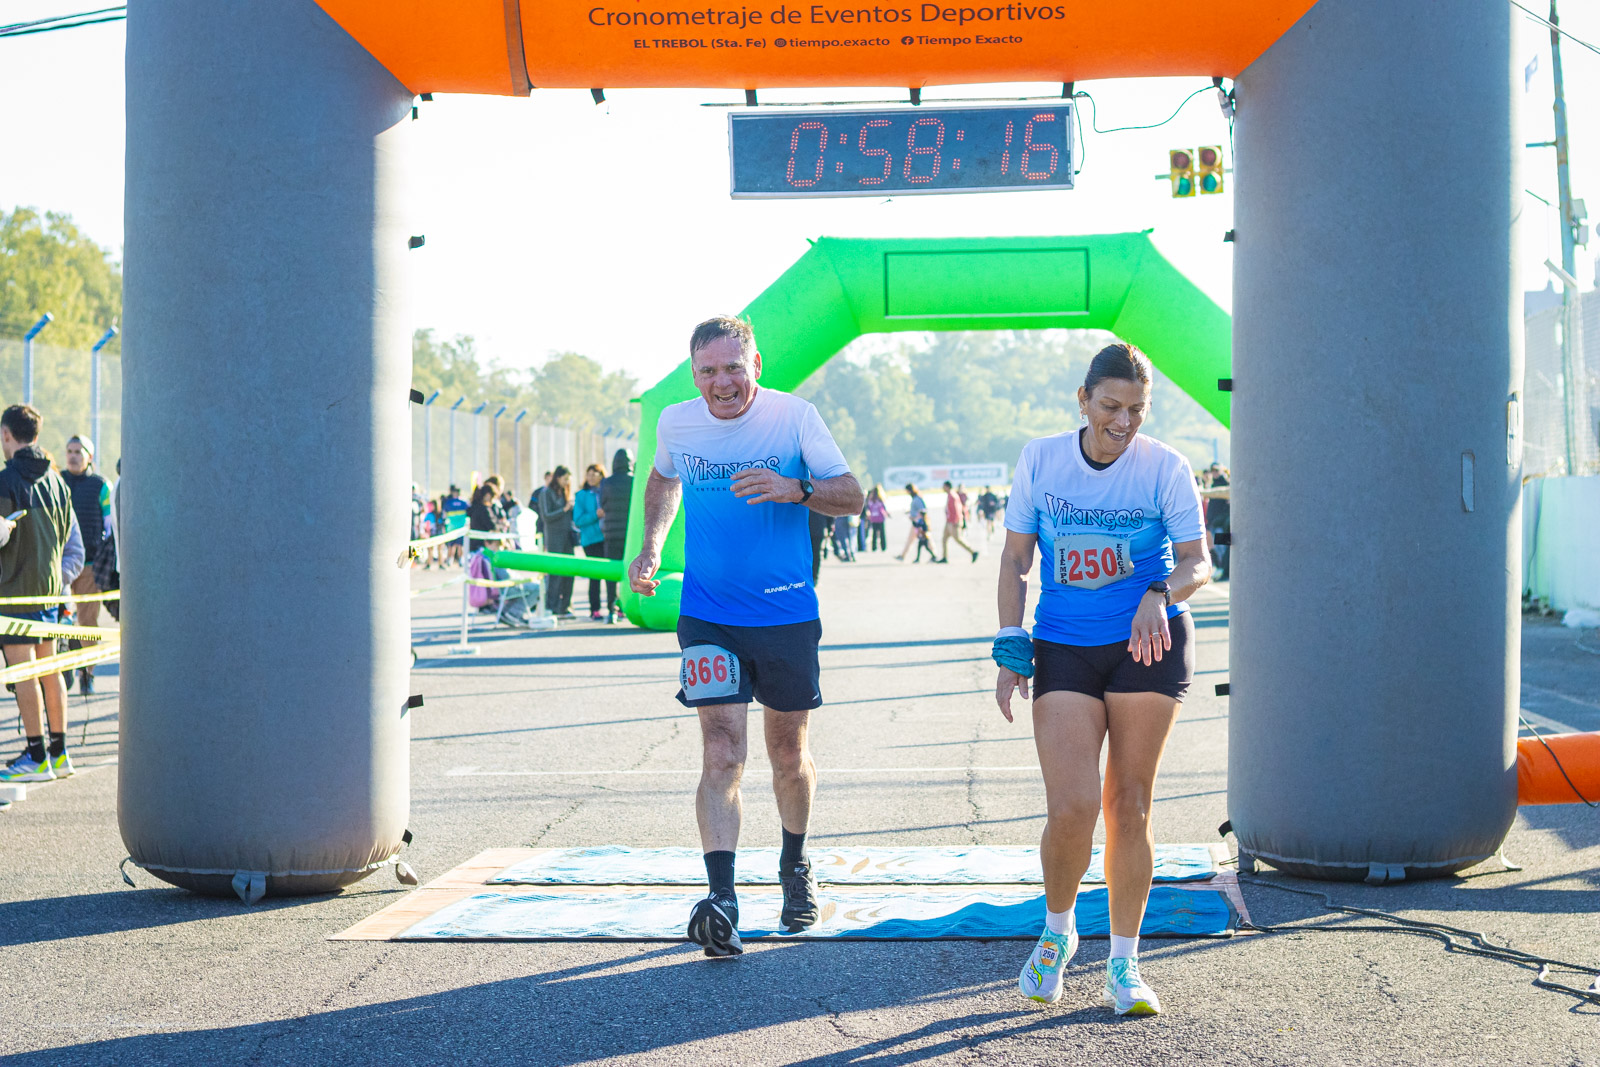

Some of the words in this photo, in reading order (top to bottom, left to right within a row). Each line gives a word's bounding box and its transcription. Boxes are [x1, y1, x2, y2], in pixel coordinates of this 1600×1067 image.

[588, 6, 763, 30] Cronometraje
[770, 5, 802, 24] de
[811, 4, 913, 24] Eventos
[920, 2, 1066, 26] Deportivos
[633, 38, 650, 49] EL
[652, 38, 708, 49] TREBOL
[710, 37, 743, 50] (Sta.
[745, 37, 767, 49] Fe)
[788, 36, 890, 49] tiempo.exacto
[916, 34, 972, 47] Tiempo
[975, 33, 1023, 45] Exacto
[1059, 548, 1068, 585] TIEMPO
[1067, 546, 1118, 582] 250
[686, 654, 728, 687] 366
[1042, 950, 1055, 960] 250
